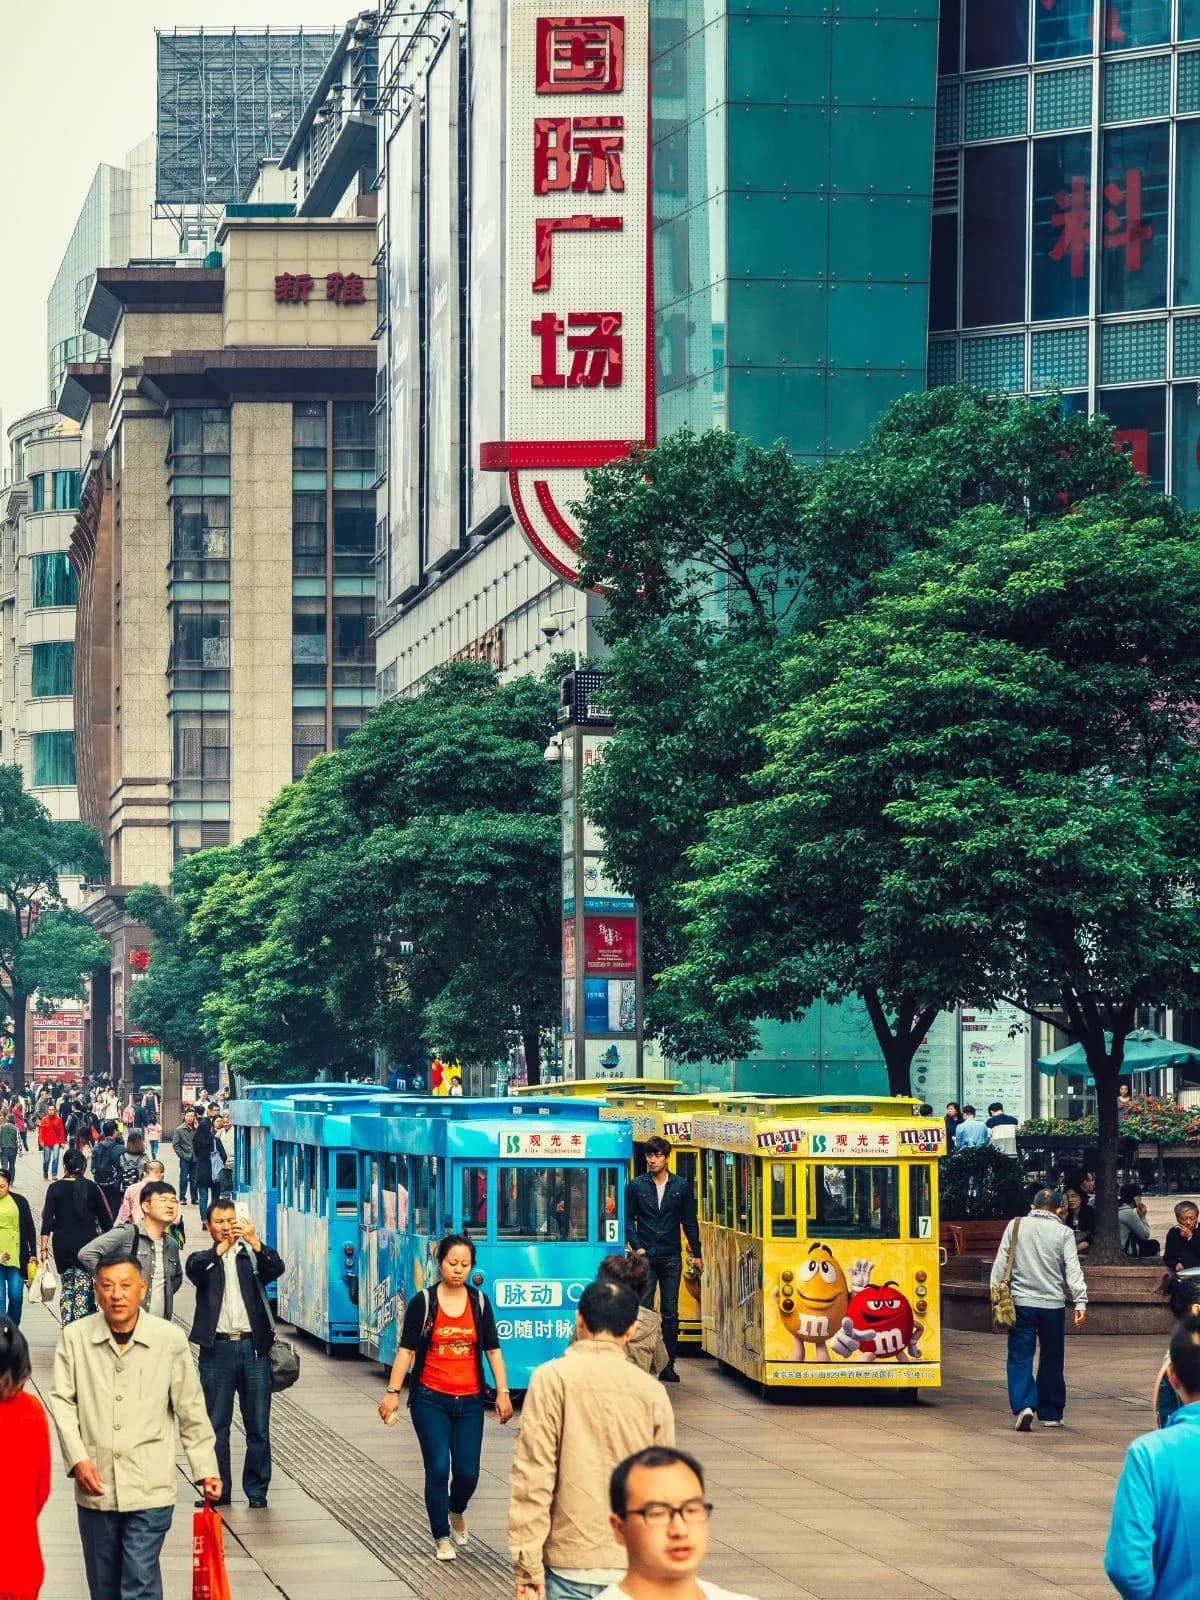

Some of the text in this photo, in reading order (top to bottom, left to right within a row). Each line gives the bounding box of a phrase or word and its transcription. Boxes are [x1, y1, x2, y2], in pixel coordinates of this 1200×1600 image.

[531, 16, 625, 388] 国际广场
[530, 1134, 582, 1147] 观光车
[836, 1134, 890, 1147] 观光车
[609, 1222, 616, 1240] 5
[921, 1218, 929, 1236] 7
[504, 1284, 553, 1304] 脉动
